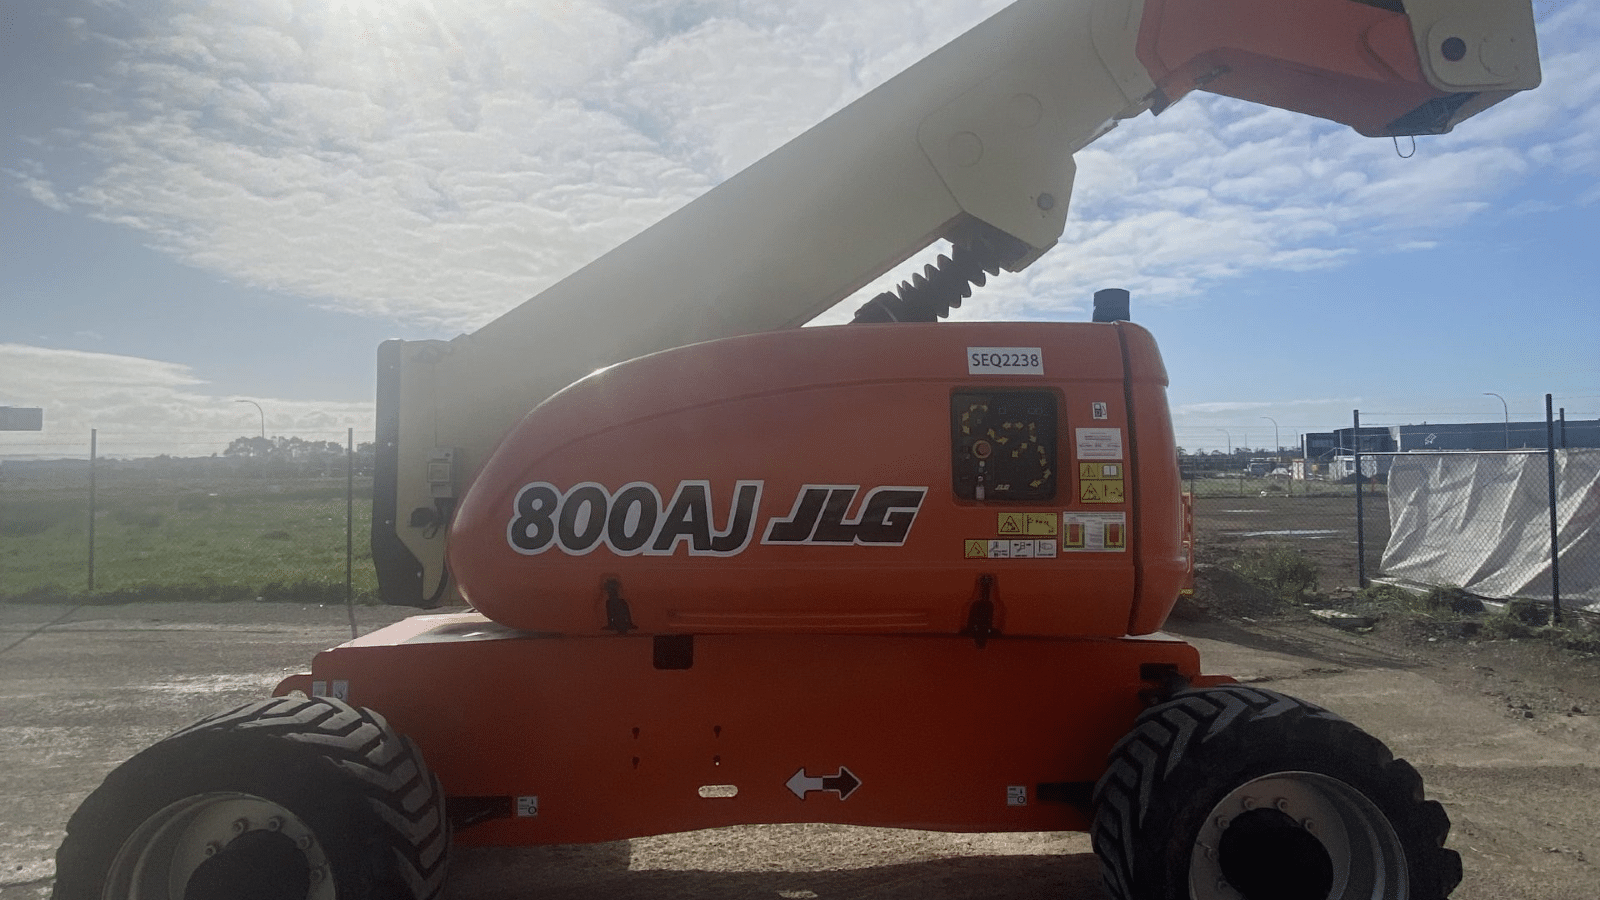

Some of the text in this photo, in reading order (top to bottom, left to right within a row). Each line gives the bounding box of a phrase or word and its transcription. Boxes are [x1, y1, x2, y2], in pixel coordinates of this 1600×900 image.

[971, 353, 1040, 368] SEQ2238
[507, 480, 929, 556] 800AJ JLG
